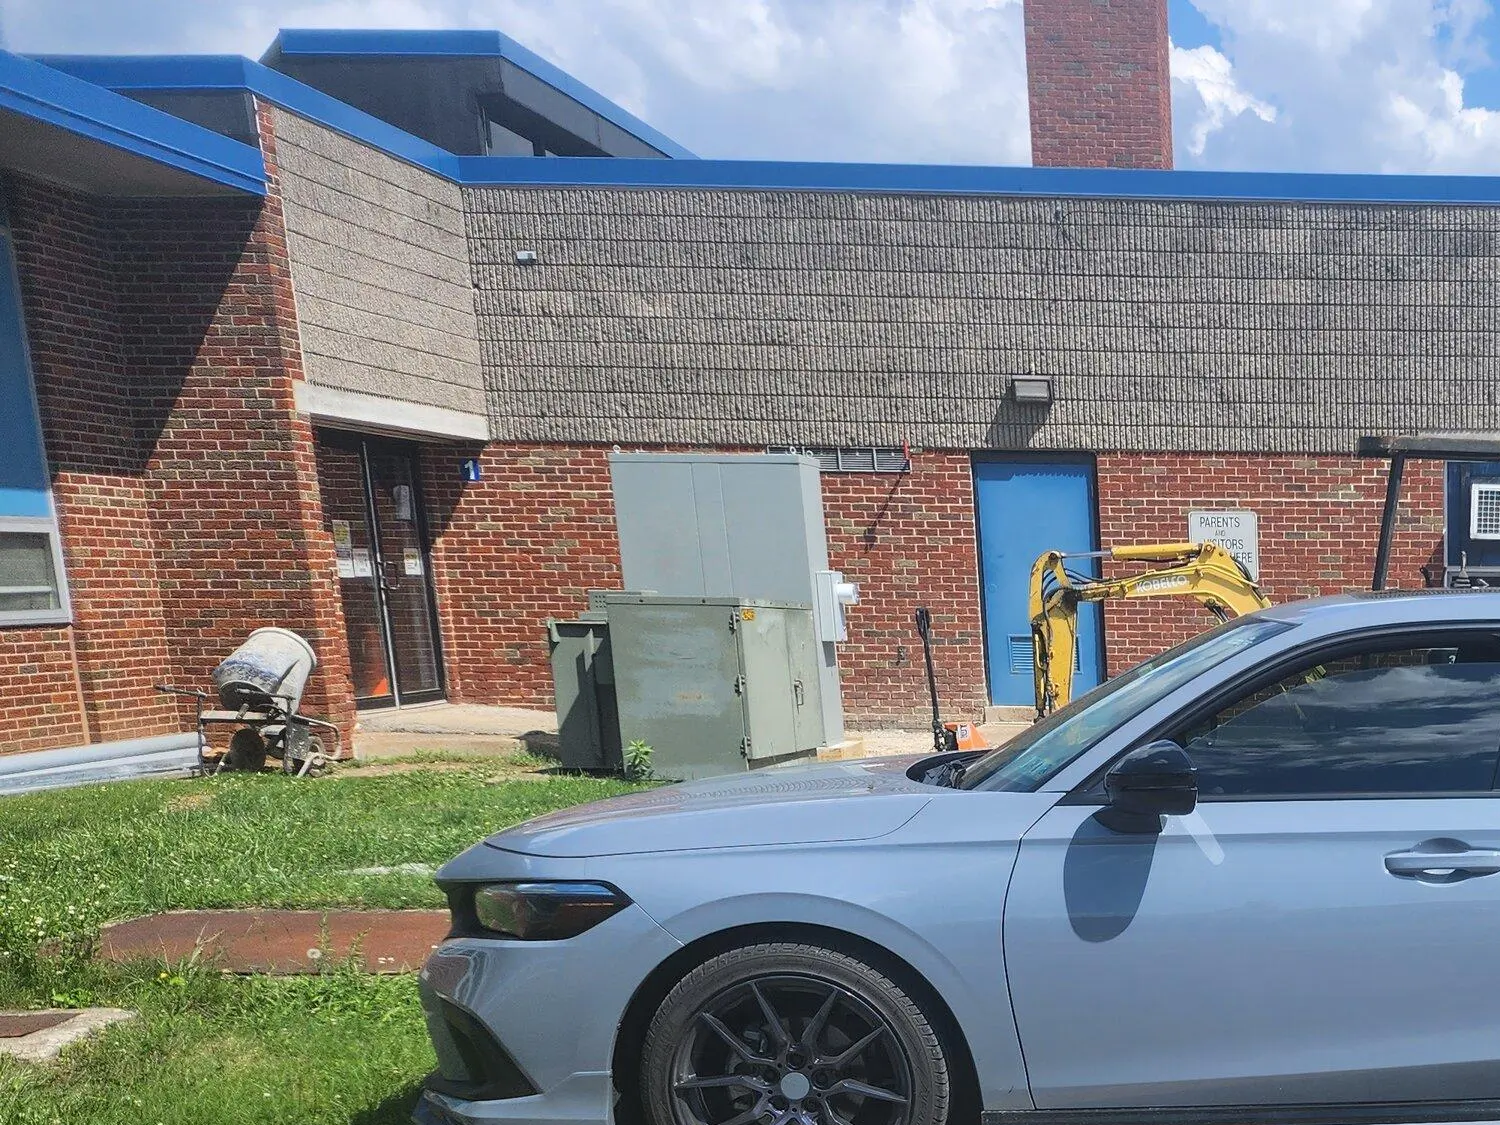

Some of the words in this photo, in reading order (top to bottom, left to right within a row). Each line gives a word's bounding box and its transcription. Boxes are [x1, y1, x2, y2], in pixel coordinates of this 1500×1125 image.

[464, 460, 476, 480] 1
[1199, 516, 1241, 528] PARENTS
[1203, 539, 1244, 550] ITORS
[1136, 575, 1187, 592] KOBELCO
